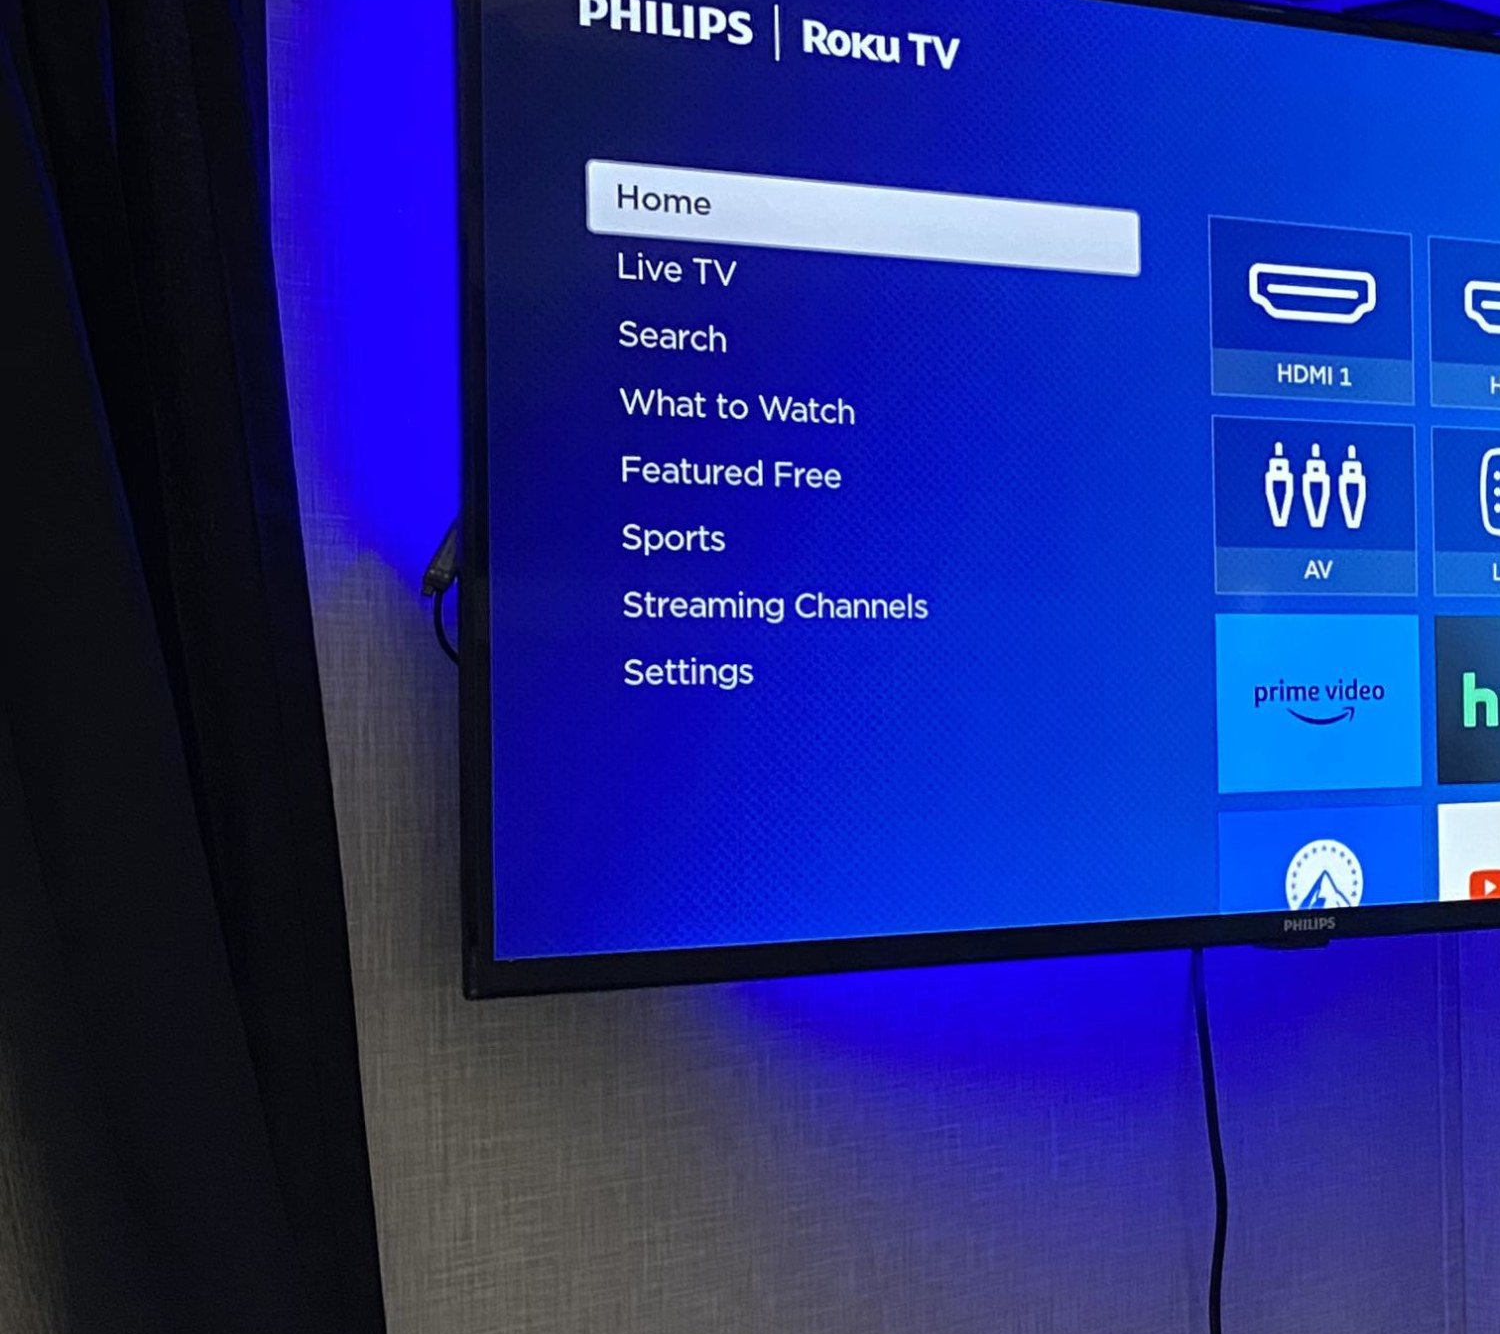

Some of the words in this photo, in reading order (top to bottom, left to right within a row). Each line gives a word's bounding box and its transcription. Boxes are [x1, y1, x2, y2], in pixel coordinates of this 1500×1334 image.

[907, 32, 961, 70] TV
[617, 183, 712, 216] Home
[618, 252, 683, 283] Live
[692, 257, 737, 287] TV
[618, 320, 727, 353] Search
[1277, 362, 1333, 386] HDMI
[1339, 367, 1352, 387] 1
[619, 387, 707, 418] What
[716, 393, 749, 420] to
[758, 394, 855, 425] Watch
[621, 455, 764, 487] Featured
[774, 461, 842, 489] Free
[622, 523, 726, 557] Sports
[1303, 559, 1334, 580] AV
[623, 590, 785, 624] Streaming
[794, 591, 929, 619] Channels
[624, 656, 754, 691] Settings
[1254, 678, 1320, 705] prime
[1324, 678, 1385, 701] video
[1283, 917, 1336, 932] PHILIPS
